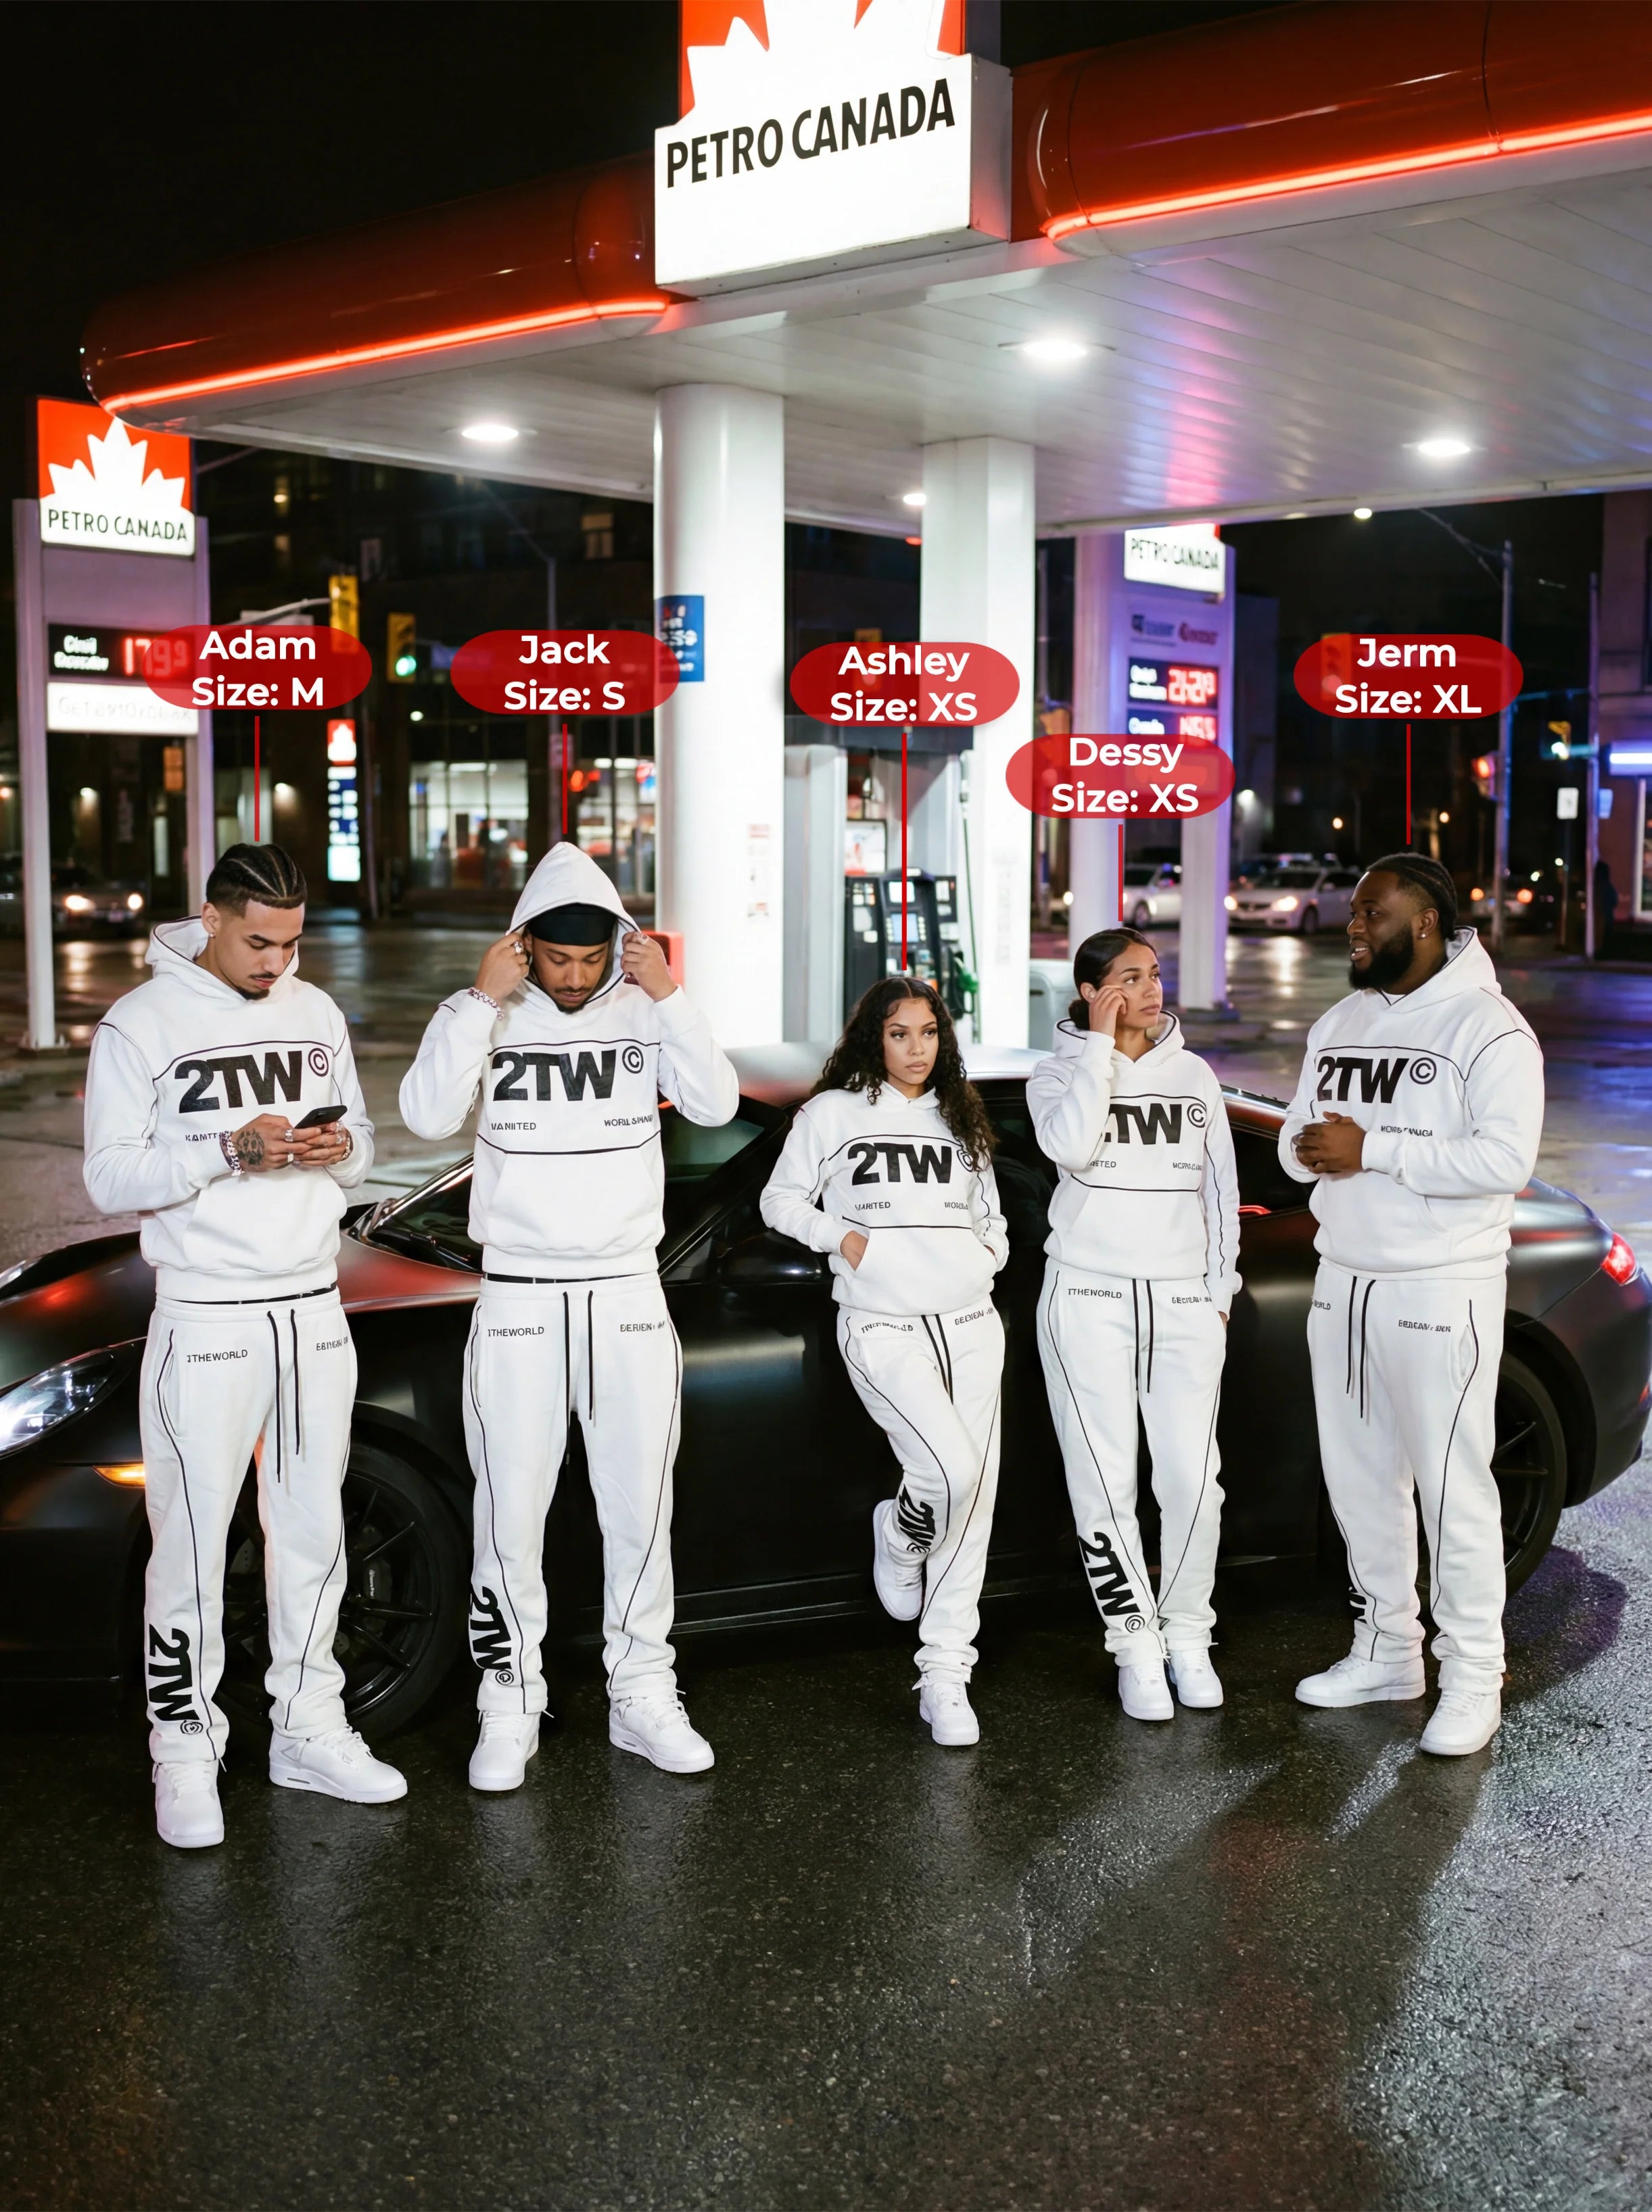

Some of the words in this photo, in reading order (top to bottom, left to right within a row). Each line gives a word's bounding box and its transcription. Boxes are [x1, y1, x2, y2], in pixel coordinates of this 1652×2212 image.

[667, 119, 783, 188] PETRO
[793, 78, 955, 159] CANADA
[48, 509, 108, 534] PETRO
[114, 516, 188, 541] CANADA
